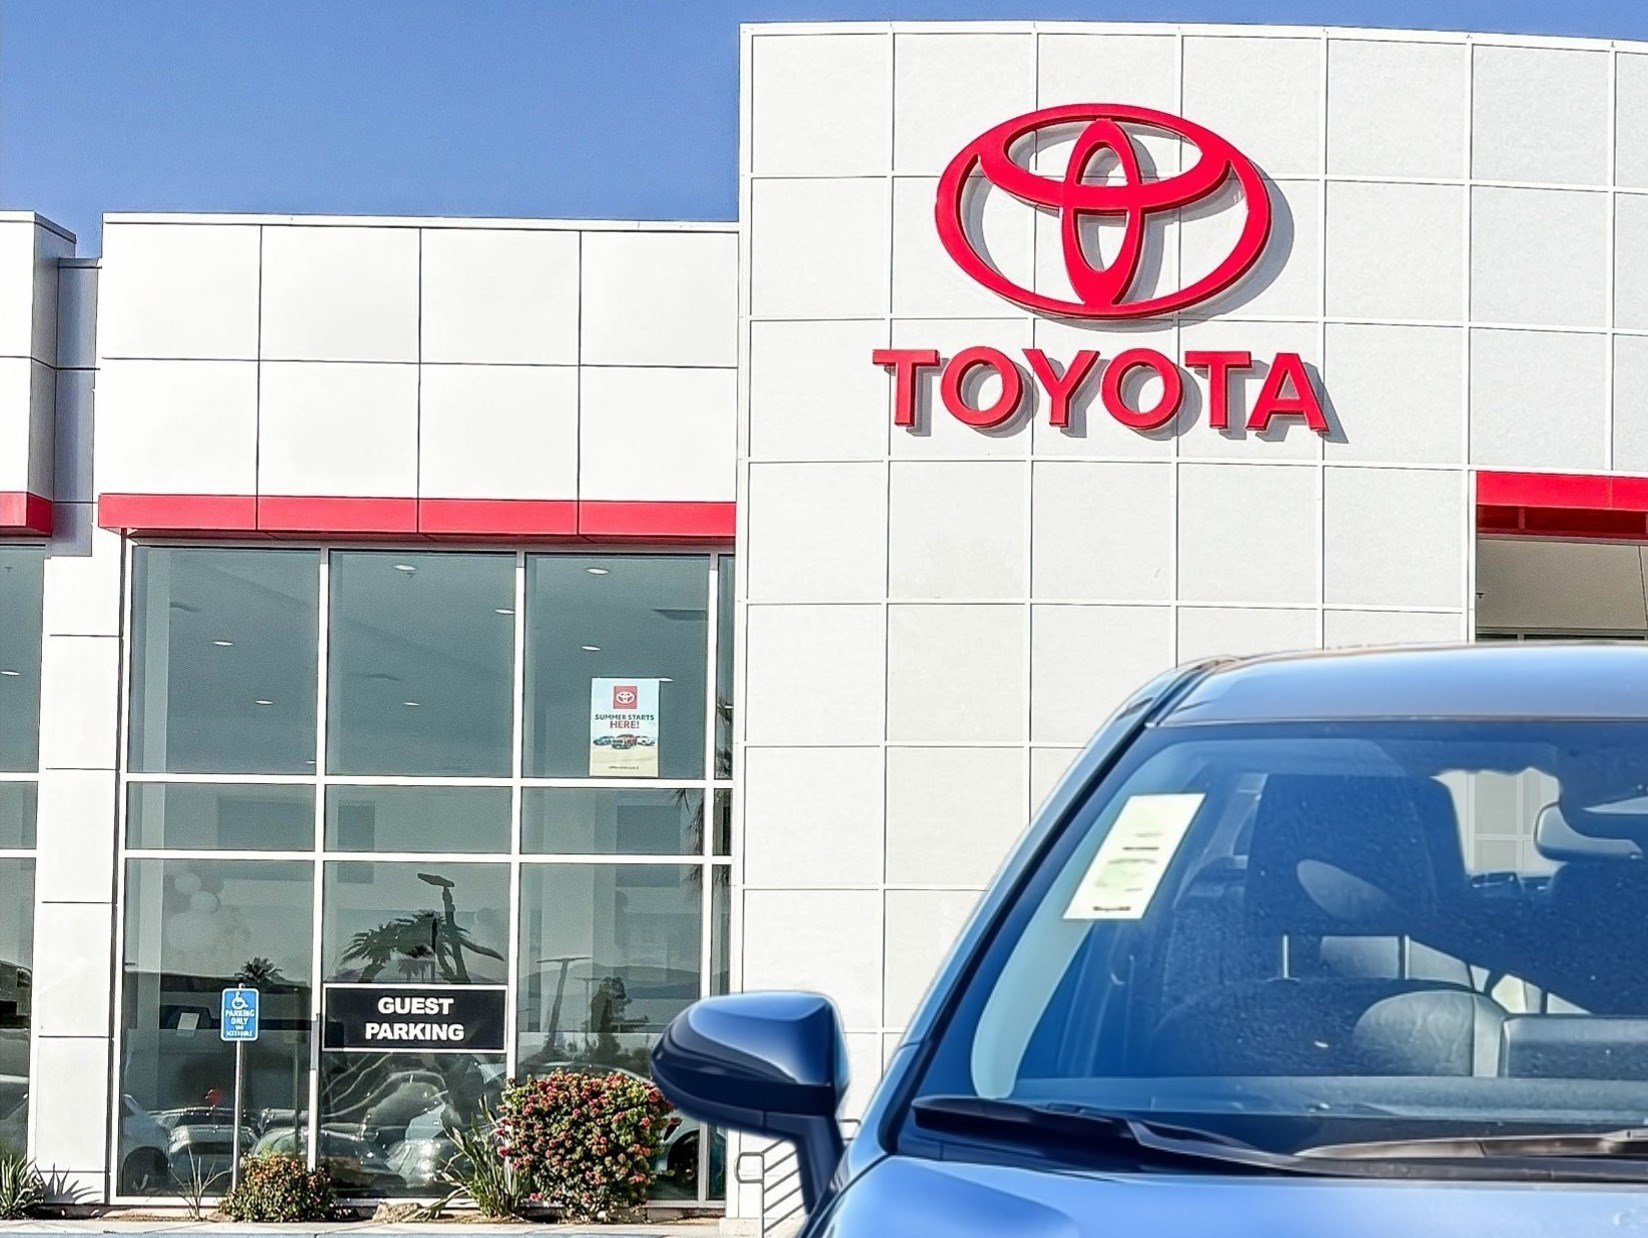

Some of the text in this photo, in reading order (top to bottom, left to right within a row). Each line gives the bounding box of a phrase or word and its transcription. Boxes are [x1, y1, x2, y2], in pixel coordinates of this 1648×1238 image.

[872, 346, 1330, 433] TOYOTA
[609, 720, 640, 729] HERE!
[225, 1009, 255, 1018] PARKING
[377, 997, 454, 1015] GUEST
[365, 1022, 464, 1041] PARKING
